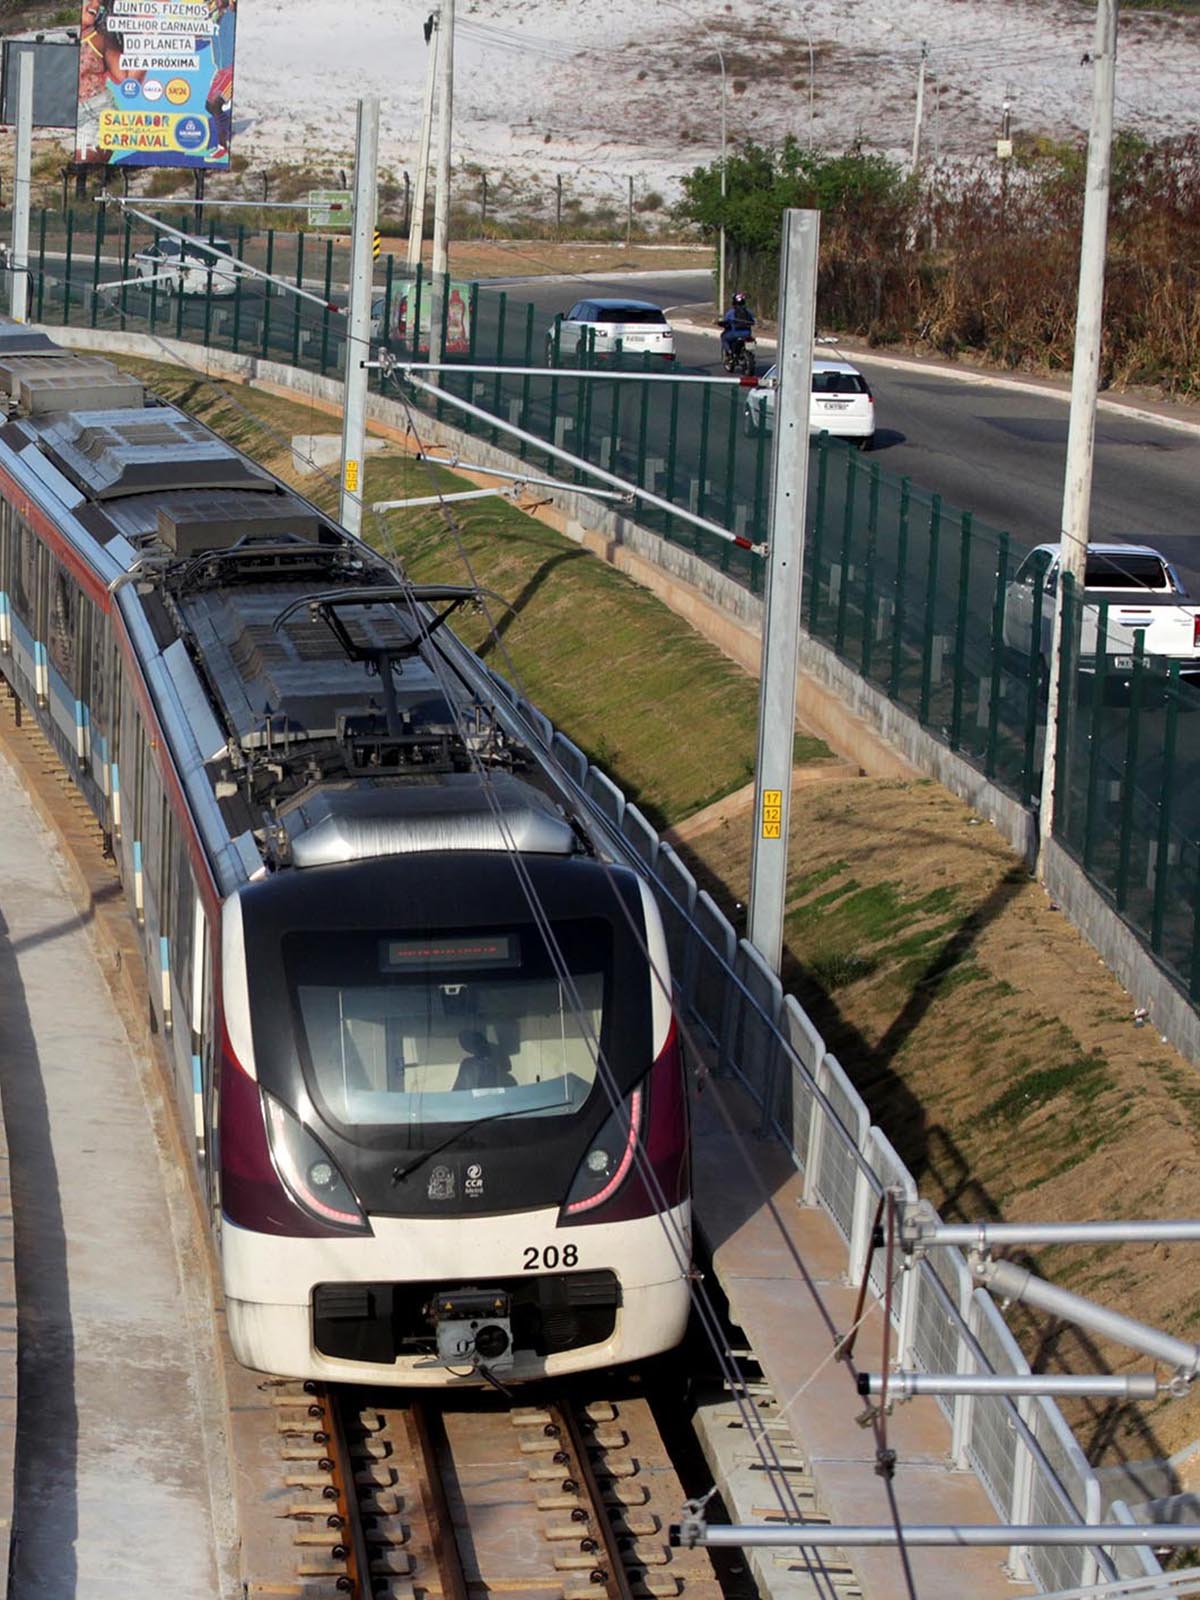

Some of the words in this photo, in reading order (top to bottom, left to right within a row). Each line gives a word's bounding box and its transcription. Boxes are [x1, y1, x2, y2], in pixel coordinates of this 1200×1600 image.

[162, 4, 208, 16] FIZEMOS
[108, 20, 116, 29] O
[117, 20, 158, 30] MELHOR
[160, 22, 211, 33] CARNAVAL
[126, 39, 141, 49] DO
[121, 56, 141, 67] ATÉ
[142, 58, 150, 67] A
[104, 114, 170, 127] SALVADOR
[103, 133, 169, 147] CARNAVAL
[766, 793, 779, 803] 17
[765, 809, 779, 819] 12
[764, 825, 779, 835] V1
[465, 1179, 483, 1187] CCR
[523, 1244, 579, 1270] 208
